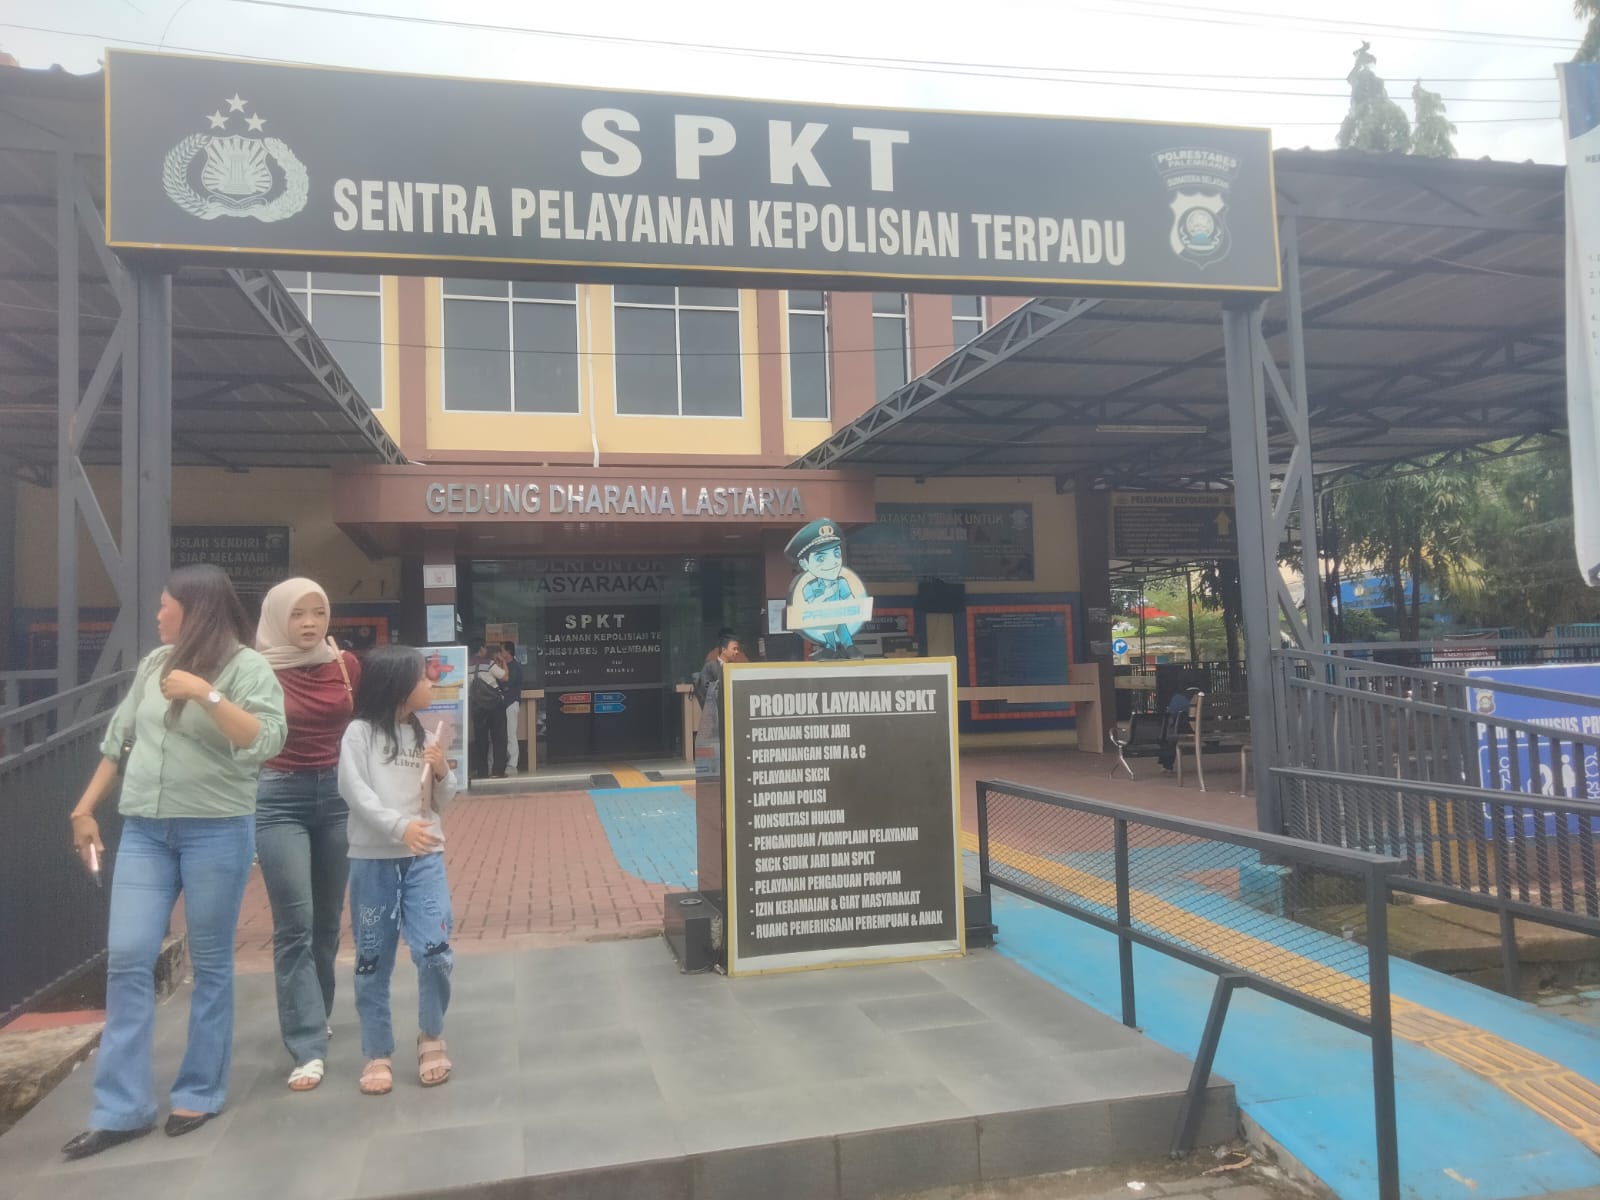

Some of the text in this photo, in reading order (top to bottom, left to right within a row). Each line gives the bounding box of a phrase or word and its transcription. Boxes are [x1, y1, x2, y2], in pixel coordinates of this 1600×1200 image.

[580, 107, 910, 192] SPKT
[1157, 150, 1237, 168] POLRESTABES
[333, 177, 1126, 266] SENTRA PELAYANAN KEPOLISIAN TERPADU
[425, 482, 806, 517] GEDUNG DHARANA LASTARYA
[879, 513, 926, 525] ATAKAN
[565, 613, 625, 629] SPKT
[544, 633, 592, 643] ELAYANAN
[651, 631, 663, 640] TE
[536, 644, 661, 656] OLRESTABES PALEMBANG
[749, 689, 936, 717] PRODUK LAYANAN SPKT
[752, 723, 850, 742] PELAYANAN SIDIK JARI
[752, 744, 866, 764] PERPANJANGAN SIM A & C
[753, 767, 830, 785] PELAYANAN SKCK
[753, 788, 827, 807] LAPORAN POLISI
[753, 809, 845, 829] KONSULTASI HUKUM
[754, 826, 919, 851] PENGANDUAN /KOMPLAIN PELAYANAN
[755, 850, 876, 873] SKCK SIDIK JARI DAN SPKT
[755, 870, 901, 895] PELAYANAN PENGADUAN PROPAM
[755, 890, 921, 917] IZIN KERAMAIAN & GIAT MASYARAKAT
[756, 910, 943, 939] RUANG PEMERIKSAAN PEREMPUAN & ANAK
